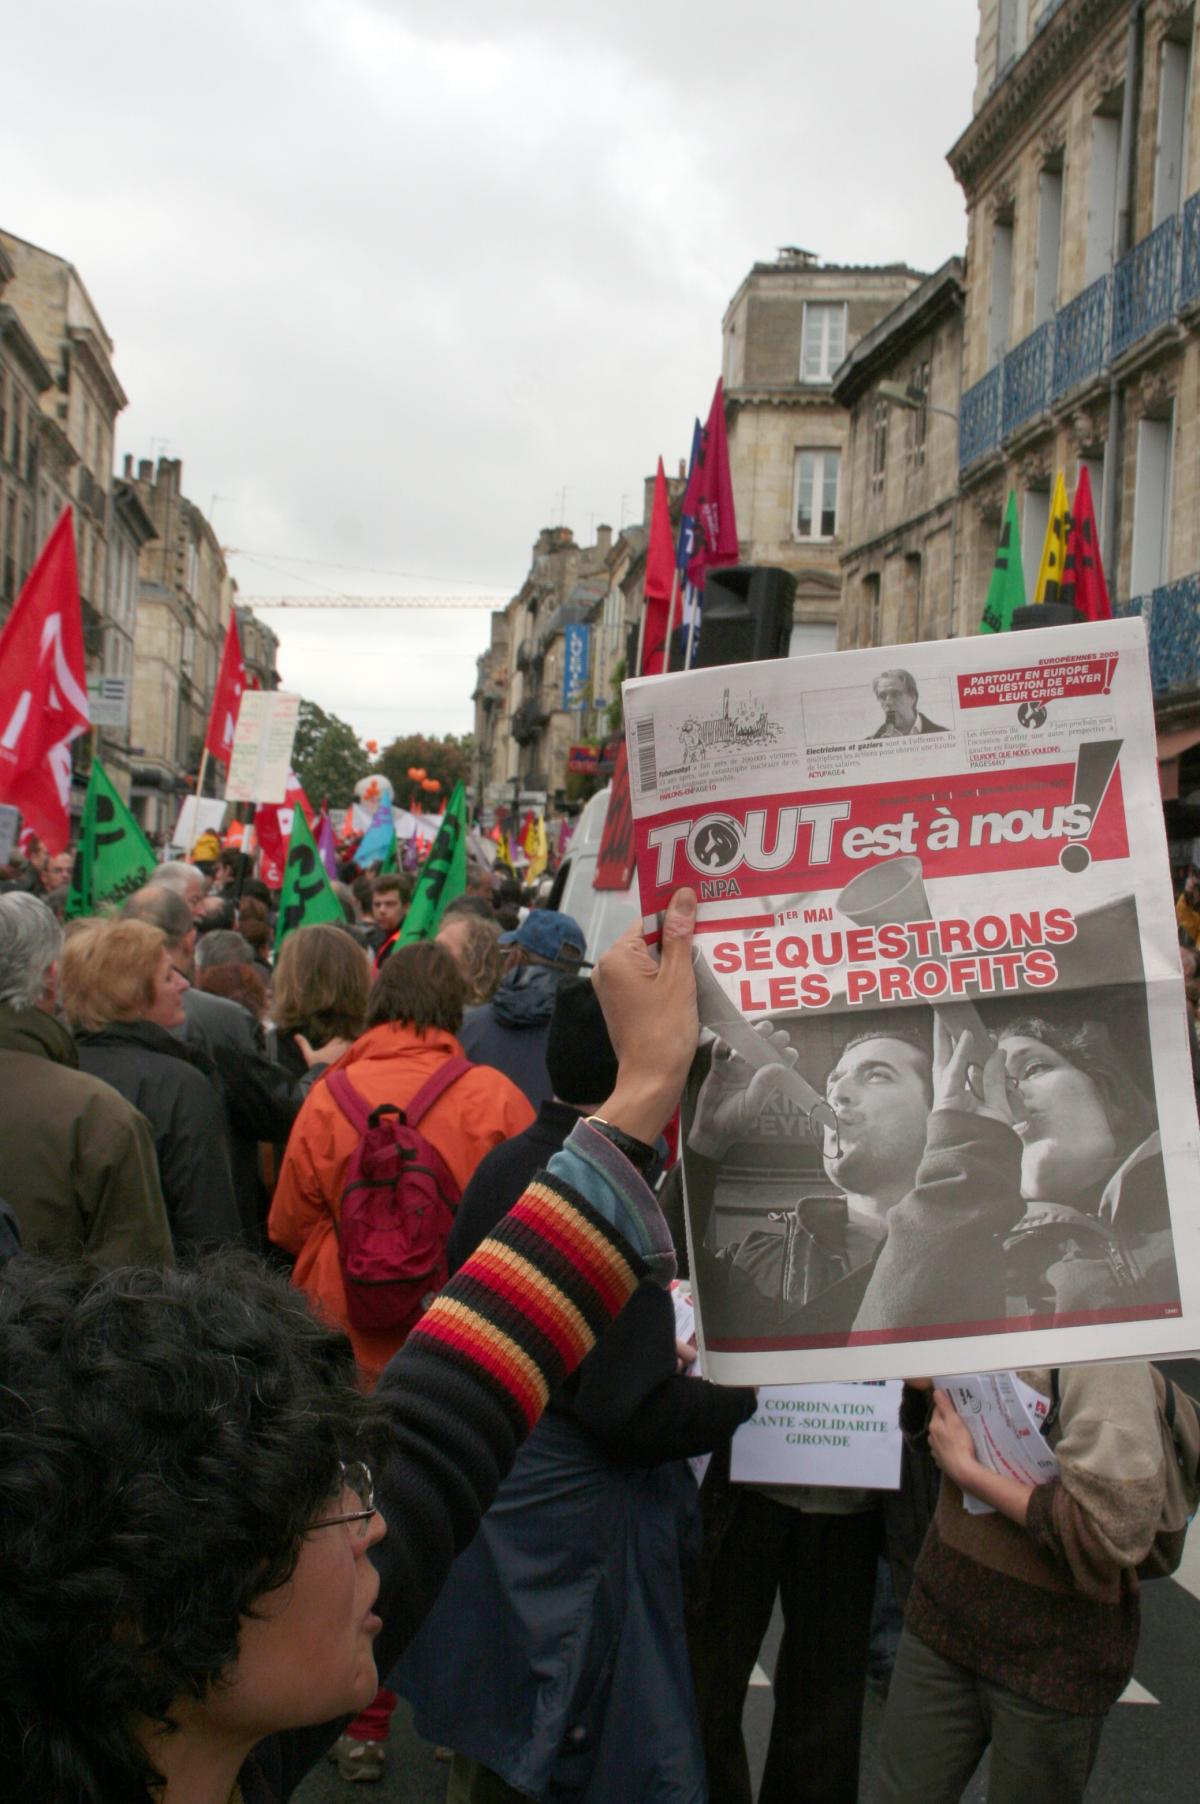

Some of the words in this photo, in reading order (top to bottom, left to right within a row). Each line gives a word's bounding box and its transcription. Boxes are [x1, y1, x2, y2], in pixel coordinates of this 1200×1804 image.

[1039, 654, 1097, 665] EUROPÉENNES
[963, 685, 985, 696] PAS
[988, 679, 1044, 693] QUESTION
[1047, 677, 1062, 686] DE
[1066, 674, 1102, 685] PAYER
[970, 672, 1022, 685] PARTOUT
[1024, 669, 1040, 680] EN
[1043, 665, 1089, 676] EUROPE
[999, 690, 1028, 702] LEUR
[1031, 687, 1064, 699] CRISE
[648, 801, 851, 886] TOUT
[842, 813, 918, 859] est
[926, 807, 959, 850] à
[701, 878, 741, 898] NPA
[777, 910, 798, 928] 1ER
[803, 907, 833, 924] MAI
[712, 908, 1077, 974] SÉQUESTRONS
[740, 973, 832, 1012] LES
[846, 949, 1057, 1005] PROFITS
[764, 1400, 875, 1415] COORDINATION
[750, 1416, 795, 1427] SANTE
[785, 1433, 850, 1447] GIRONDE
